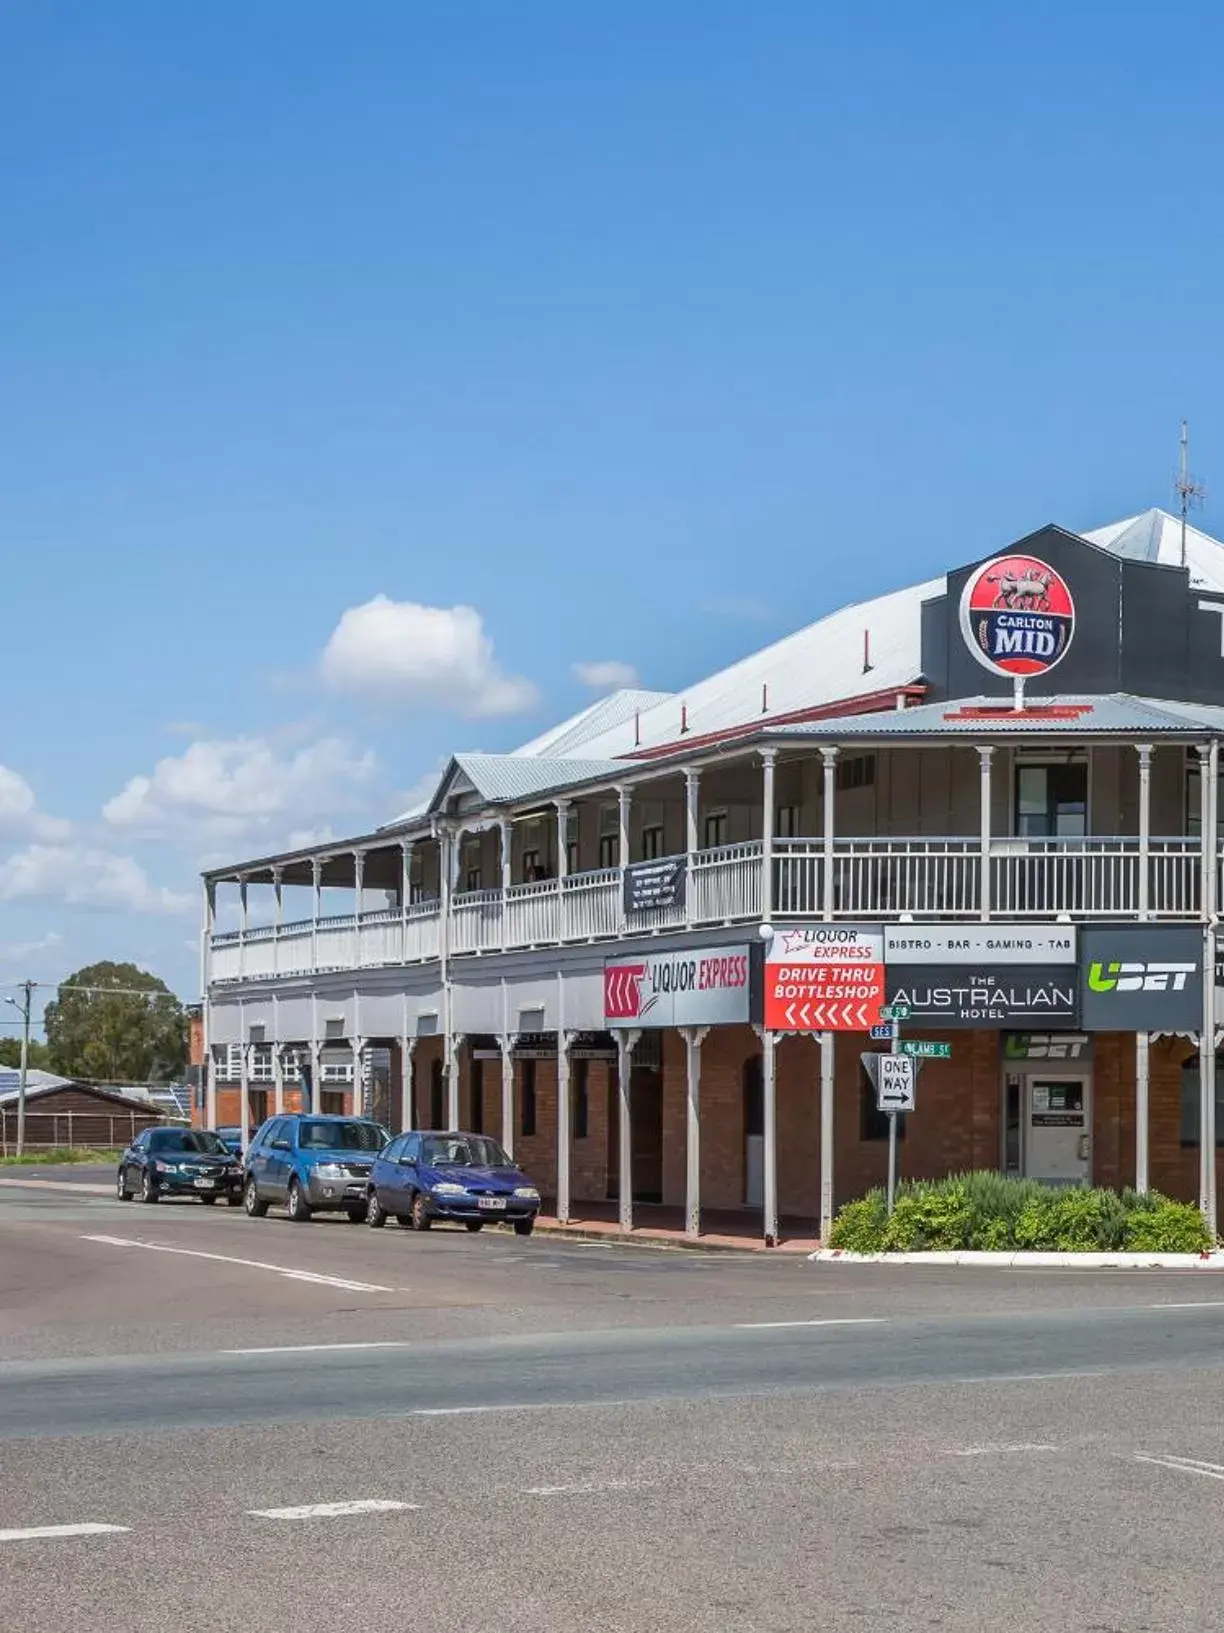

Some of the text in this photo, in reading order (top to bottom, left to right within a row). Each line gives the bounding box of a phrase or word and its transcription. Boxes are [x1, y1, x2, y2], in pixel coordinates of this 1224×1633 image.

[997, 615, 1053, 630] CARLTON
[994, 628, 1055, 656] MID
[804, 930, 858, 944] LIQUOR
[889, 940, 931, 949] BISTRO
[947, 940, 970, 949] BAR
[986, 940, 1032, 949] GAMING
[1050, 940, 1070, 949] TAB
[814, 946, 872, 958] EXPRESS
[653, 956, 747, 993] LIQUOR EXPRESS
[778, 968, 875, 982] DRIVE THRU
[970, 976, 995, 985] THE
[1089, 963, 1196, 992] UBET
[774, 985, 879, 999] BOTTLESHOP
[891, 988, 1073, 1006] AUSTRALIAN
[961, 1009, 1005, 1018] HOTEL
[884, 1061, 909, 1073] ONE
[884, 1077, 910, 1090] WAY
